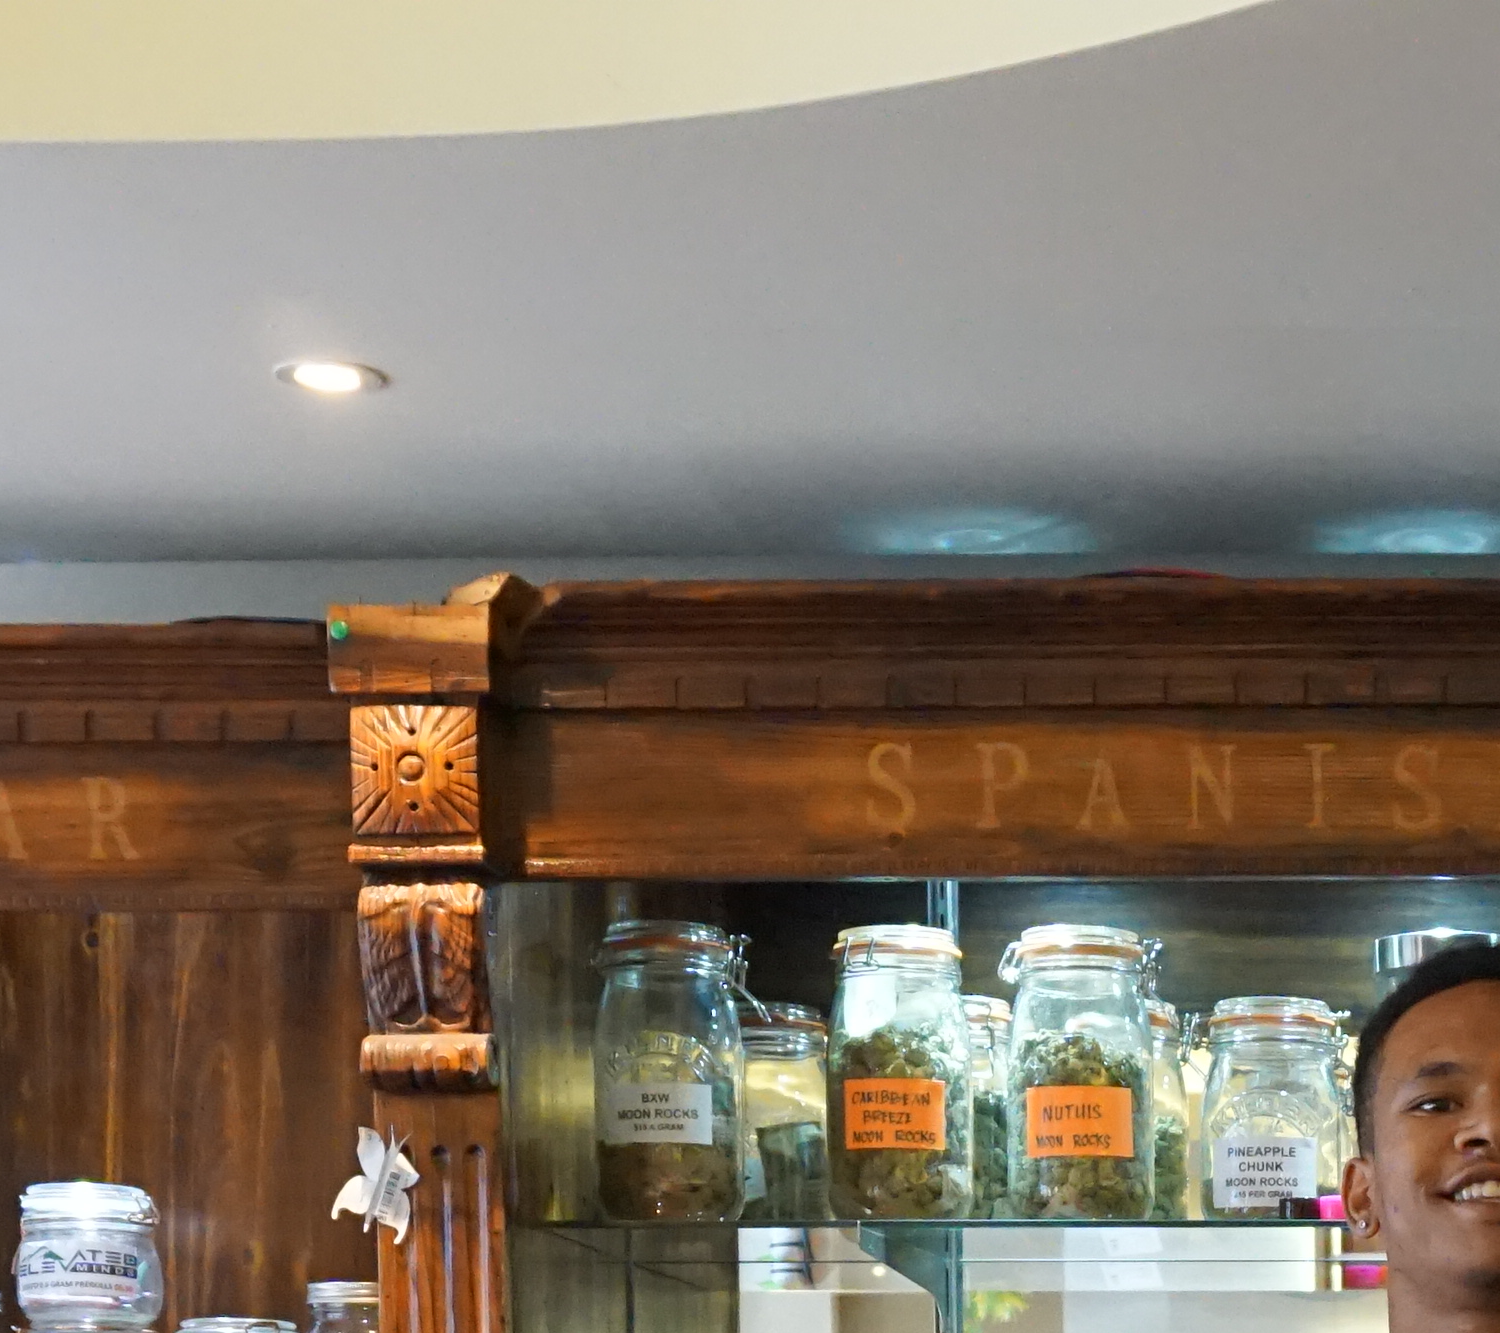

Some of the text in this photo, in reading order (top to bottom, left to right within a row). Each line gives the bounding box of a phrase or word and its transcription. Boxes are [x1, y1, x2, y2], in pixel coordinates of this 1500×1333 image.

[640, 1092, 670, 1104] BXW
[617, 1108, 700, 1120] MOON ROCKS
[852, 1130, 937, 1146] MOON ROCKS
[1034, 1133, 1112, 1148] MOON ROCKS
[1227, 1146, 1297, 1158] PINEAPPLE
[1238, 1161, 1285, 1173] CHUNK
[1224, 1176, 1299, 1188] MOON ROCKS
[74, 1262, 137, 1279] MINDS
